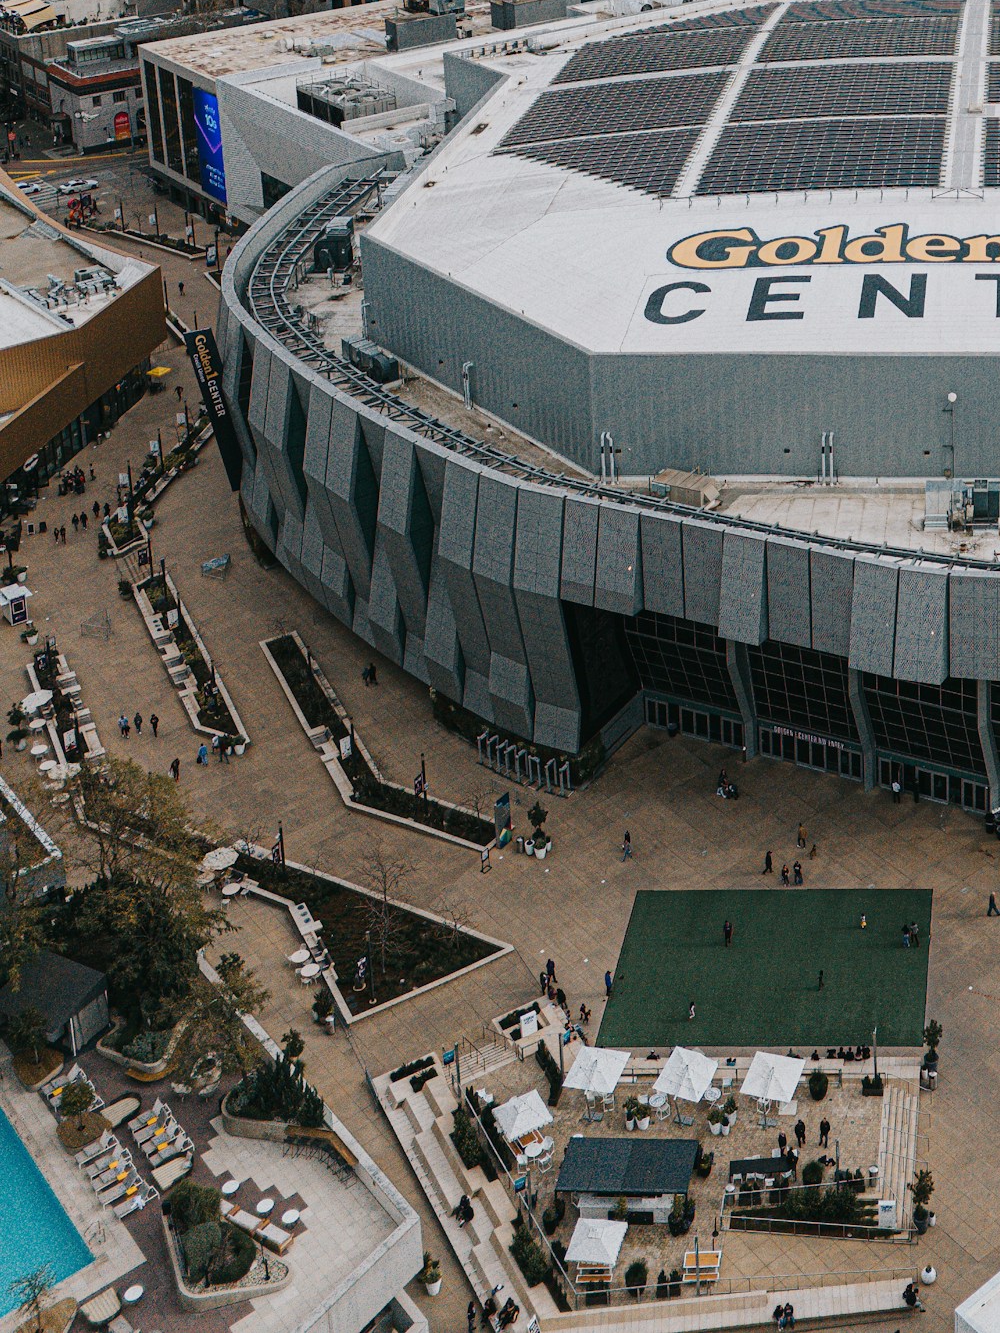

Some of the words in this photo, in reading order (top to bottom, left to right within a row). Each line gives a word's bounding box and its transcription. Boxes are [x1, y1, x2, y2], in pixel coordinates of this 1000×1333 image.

[207, 379, 226, 418] CENTER
[773, 725, 794, 737] GOLDEN
[797, 732, 817, 743] CENTER
[828, 740, 845, 750] ENTRY
